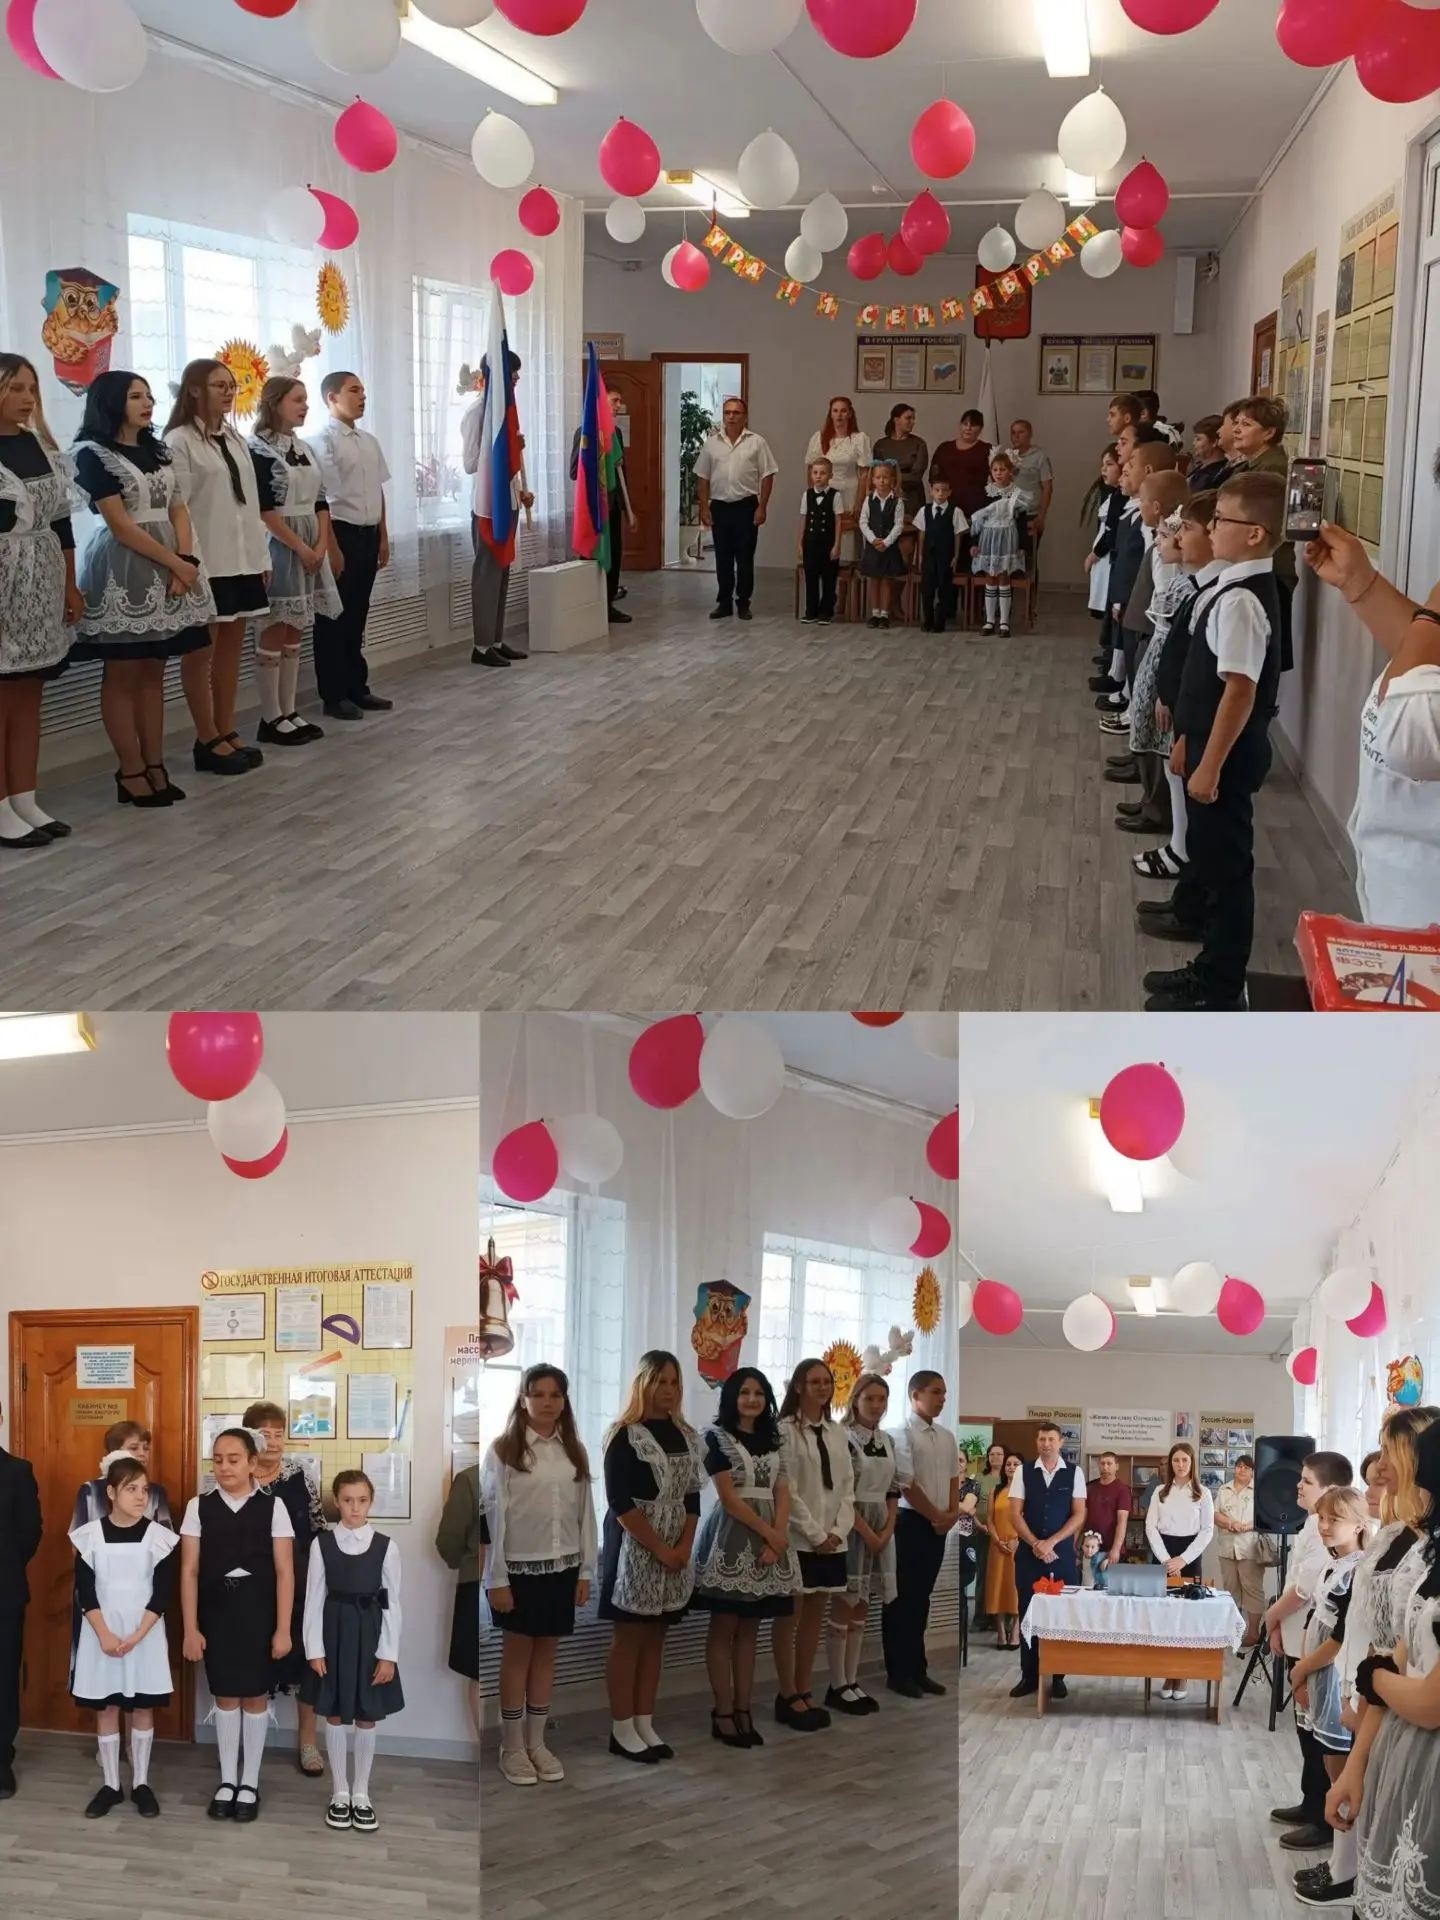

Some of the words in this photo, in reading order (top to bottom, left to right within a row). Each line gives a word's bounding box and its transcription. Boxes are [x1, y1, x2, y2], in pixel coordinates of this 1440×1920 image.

[861, 221, 1088, 326] СЕНТЯБРЯ!
[220, 1271, 303, 1288] ГОСУДАРСТВЕННАЯ
[305, 1269, 351, 1284] ИТОГОВАЯ
[353, 1266, 413, 1282] АТТЕСТАЦИЯ
[450, 1357, 480, 1367] мероп
